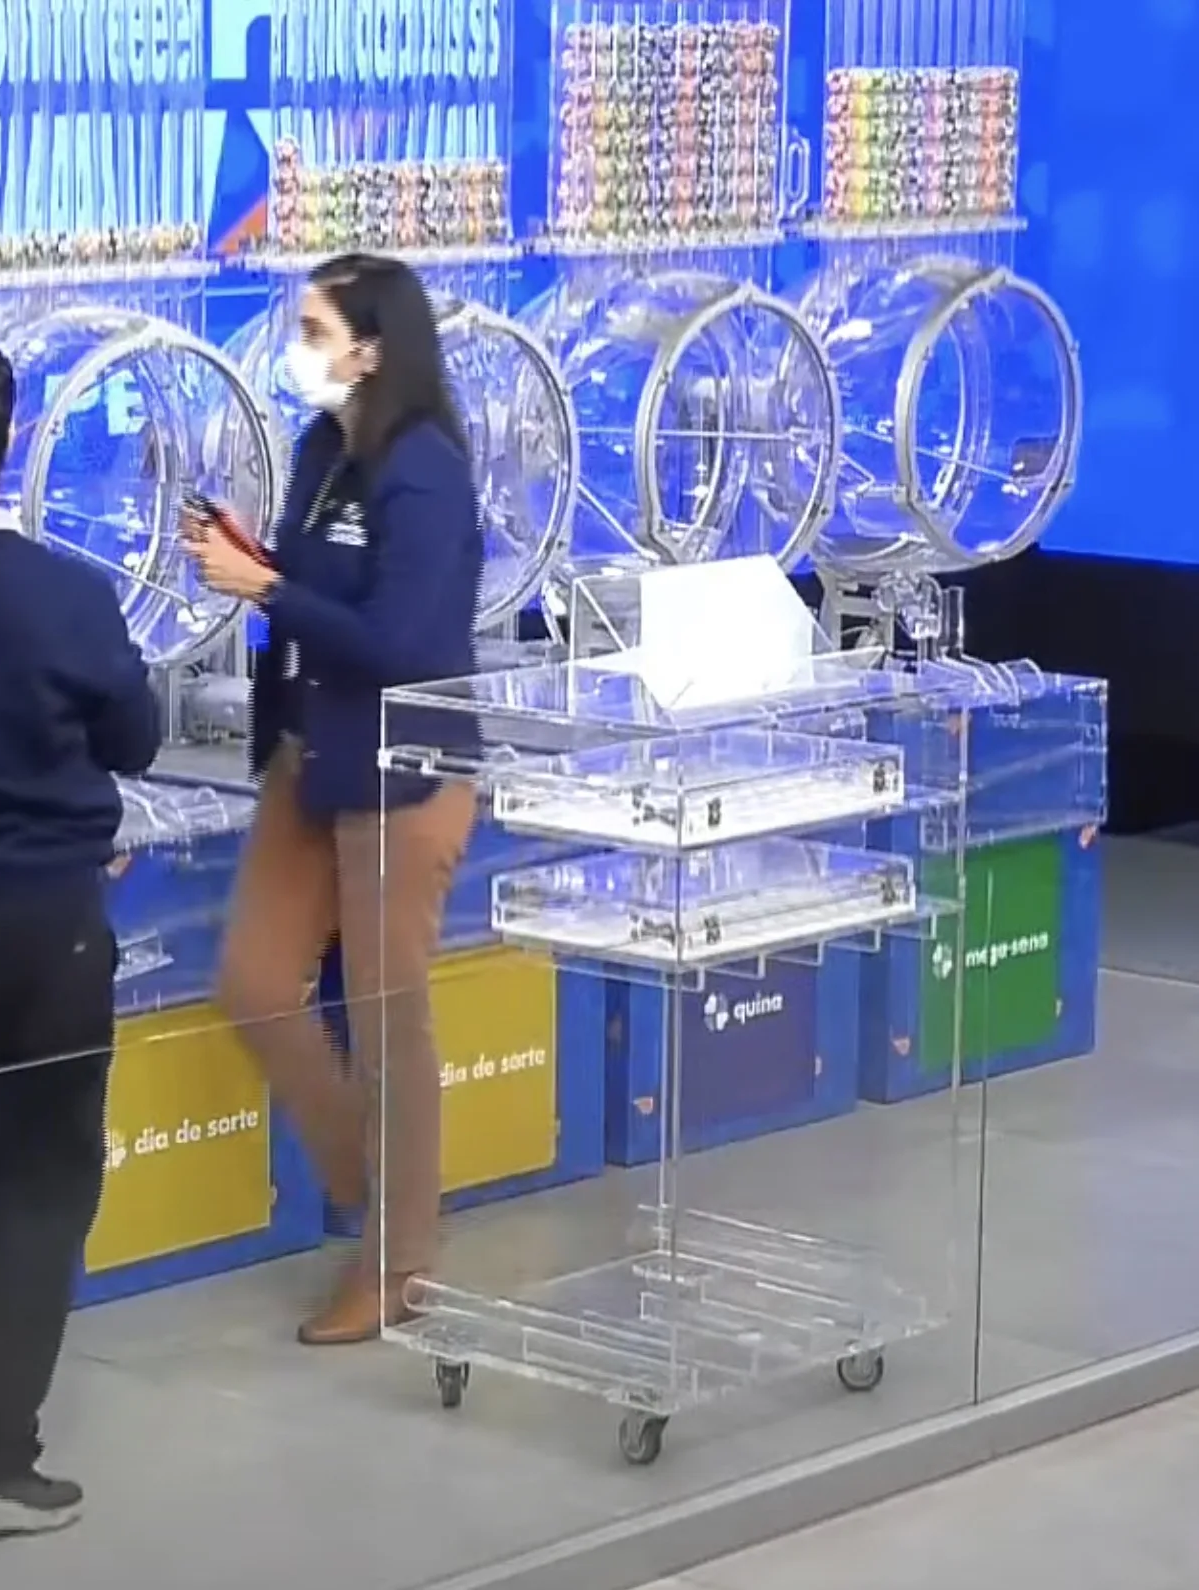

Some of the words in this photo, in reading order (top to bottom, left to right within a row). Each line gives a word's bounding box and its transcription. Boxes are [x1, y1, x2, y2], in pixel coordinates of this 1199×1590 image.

[733, 990, 783, 1025] quina
[134, 1126, 169, 1154] dia
[207, 1108, 259, 1137] sorte
